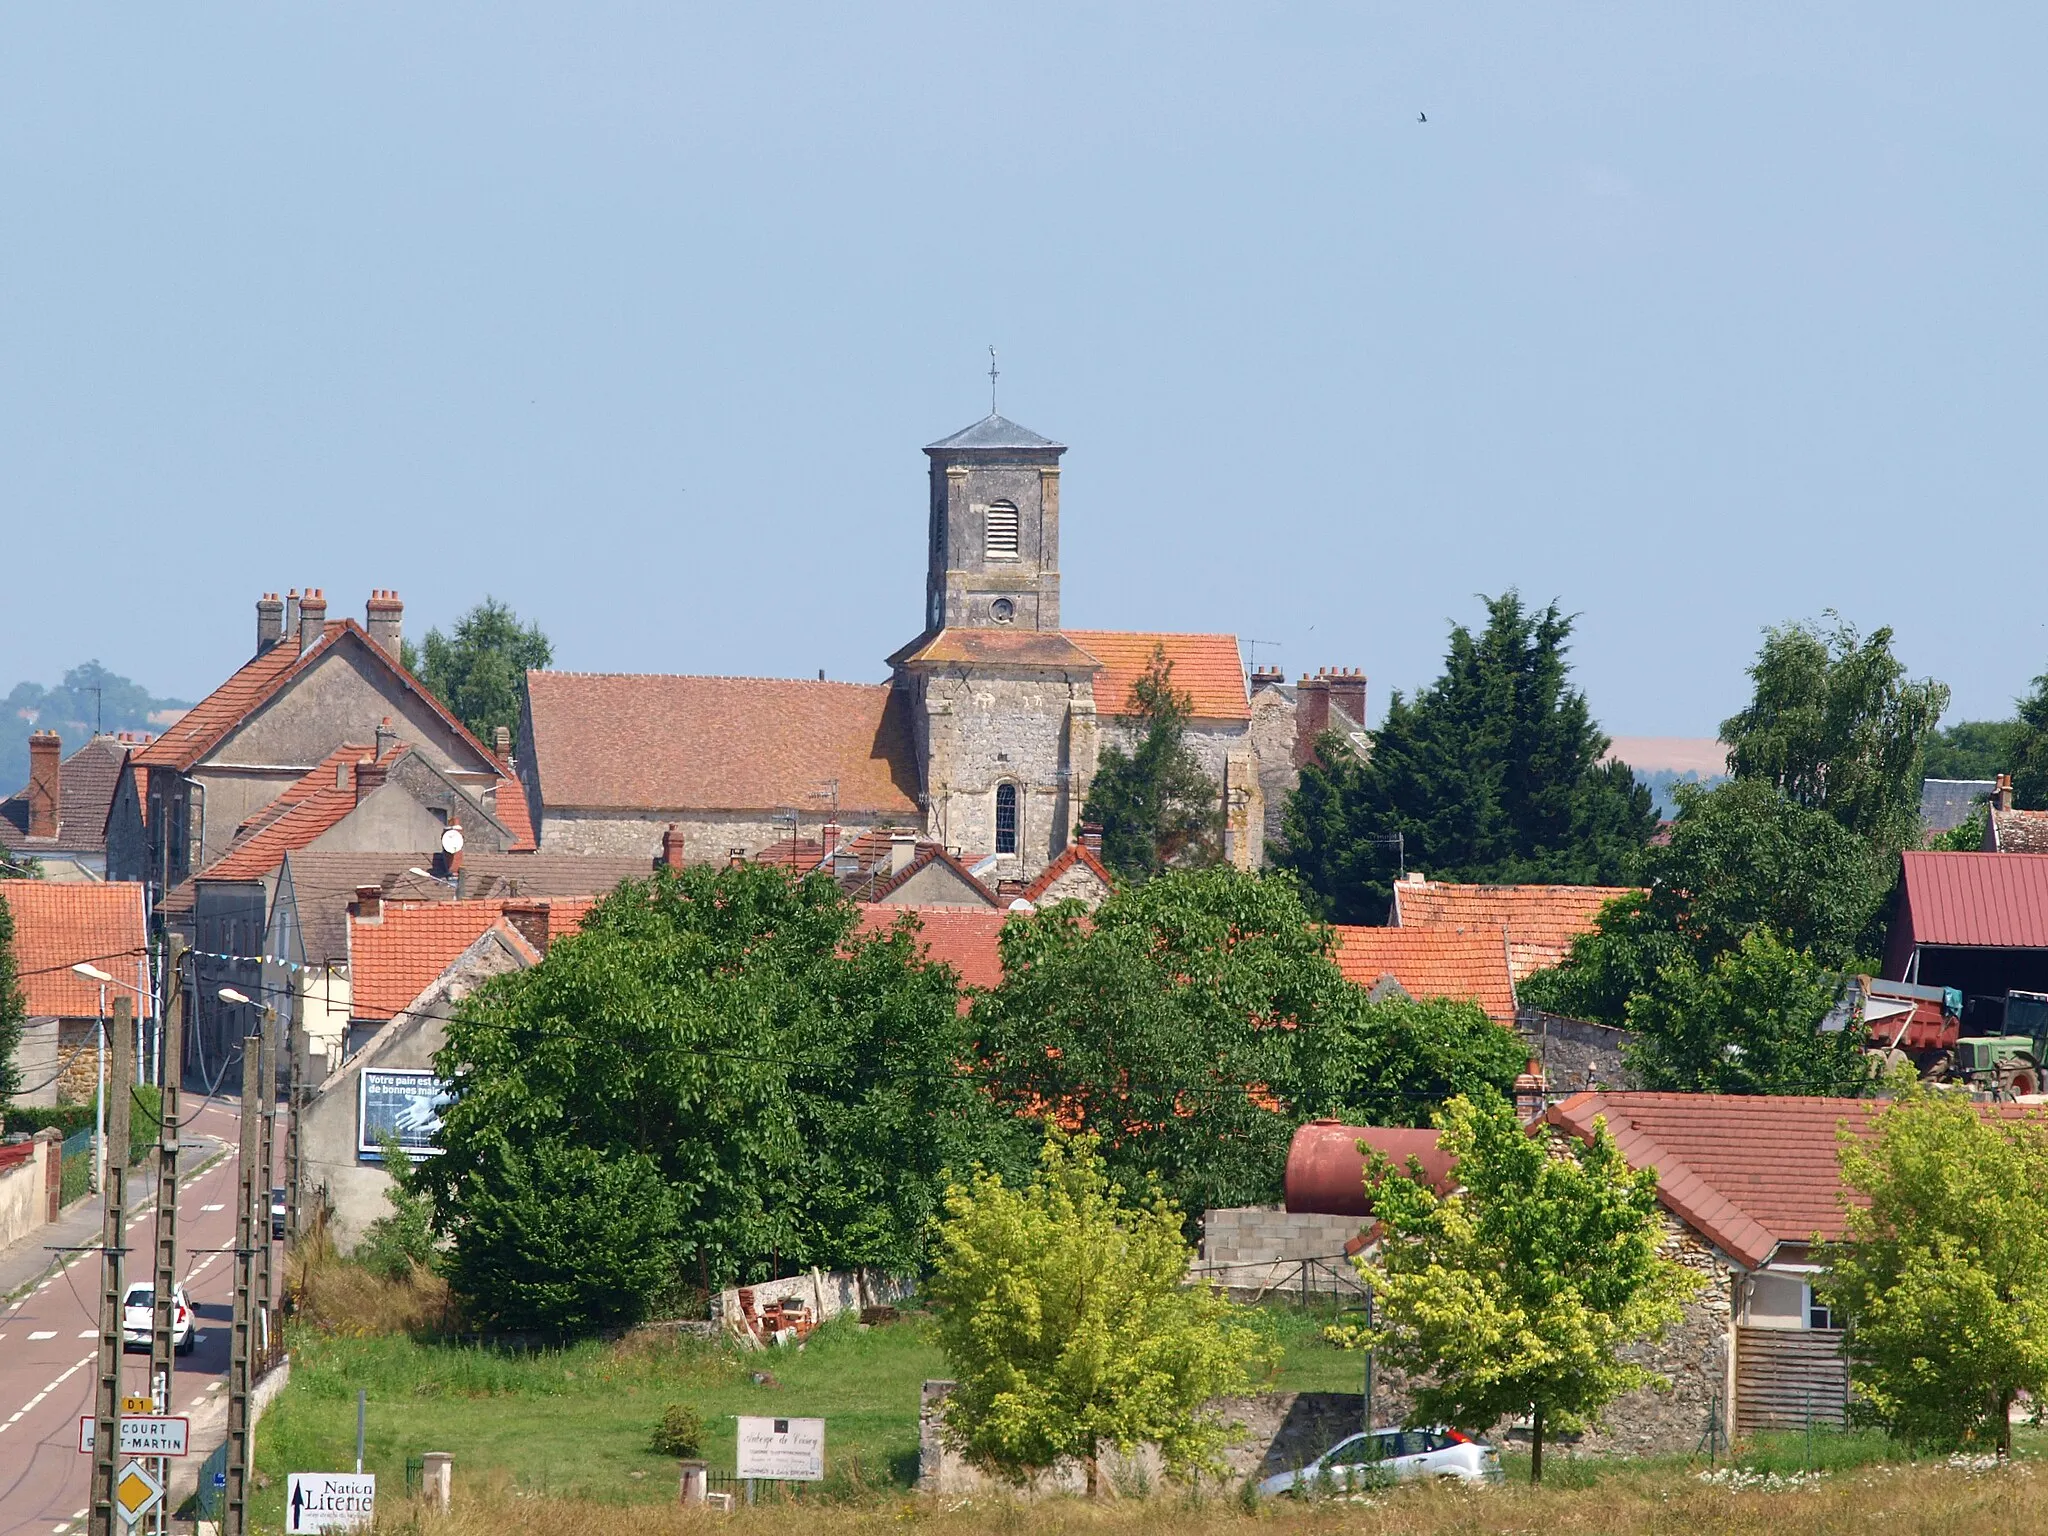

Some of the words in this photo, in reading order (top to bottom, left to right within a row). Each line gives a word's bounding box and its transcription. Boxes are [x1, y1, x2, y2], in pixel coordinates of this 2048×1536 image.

[368, 1075, 394, 1085] Votre
[395, 1076, 416, 1086] pain
[417, 1077, 431, 1086] est
[368, 1084, 380, 1093] de
[382, 1085, 417, 1095] bonnes
[324, 1480, 372, 1494] Nation
[304, 1489, 372, 1512] Literie
